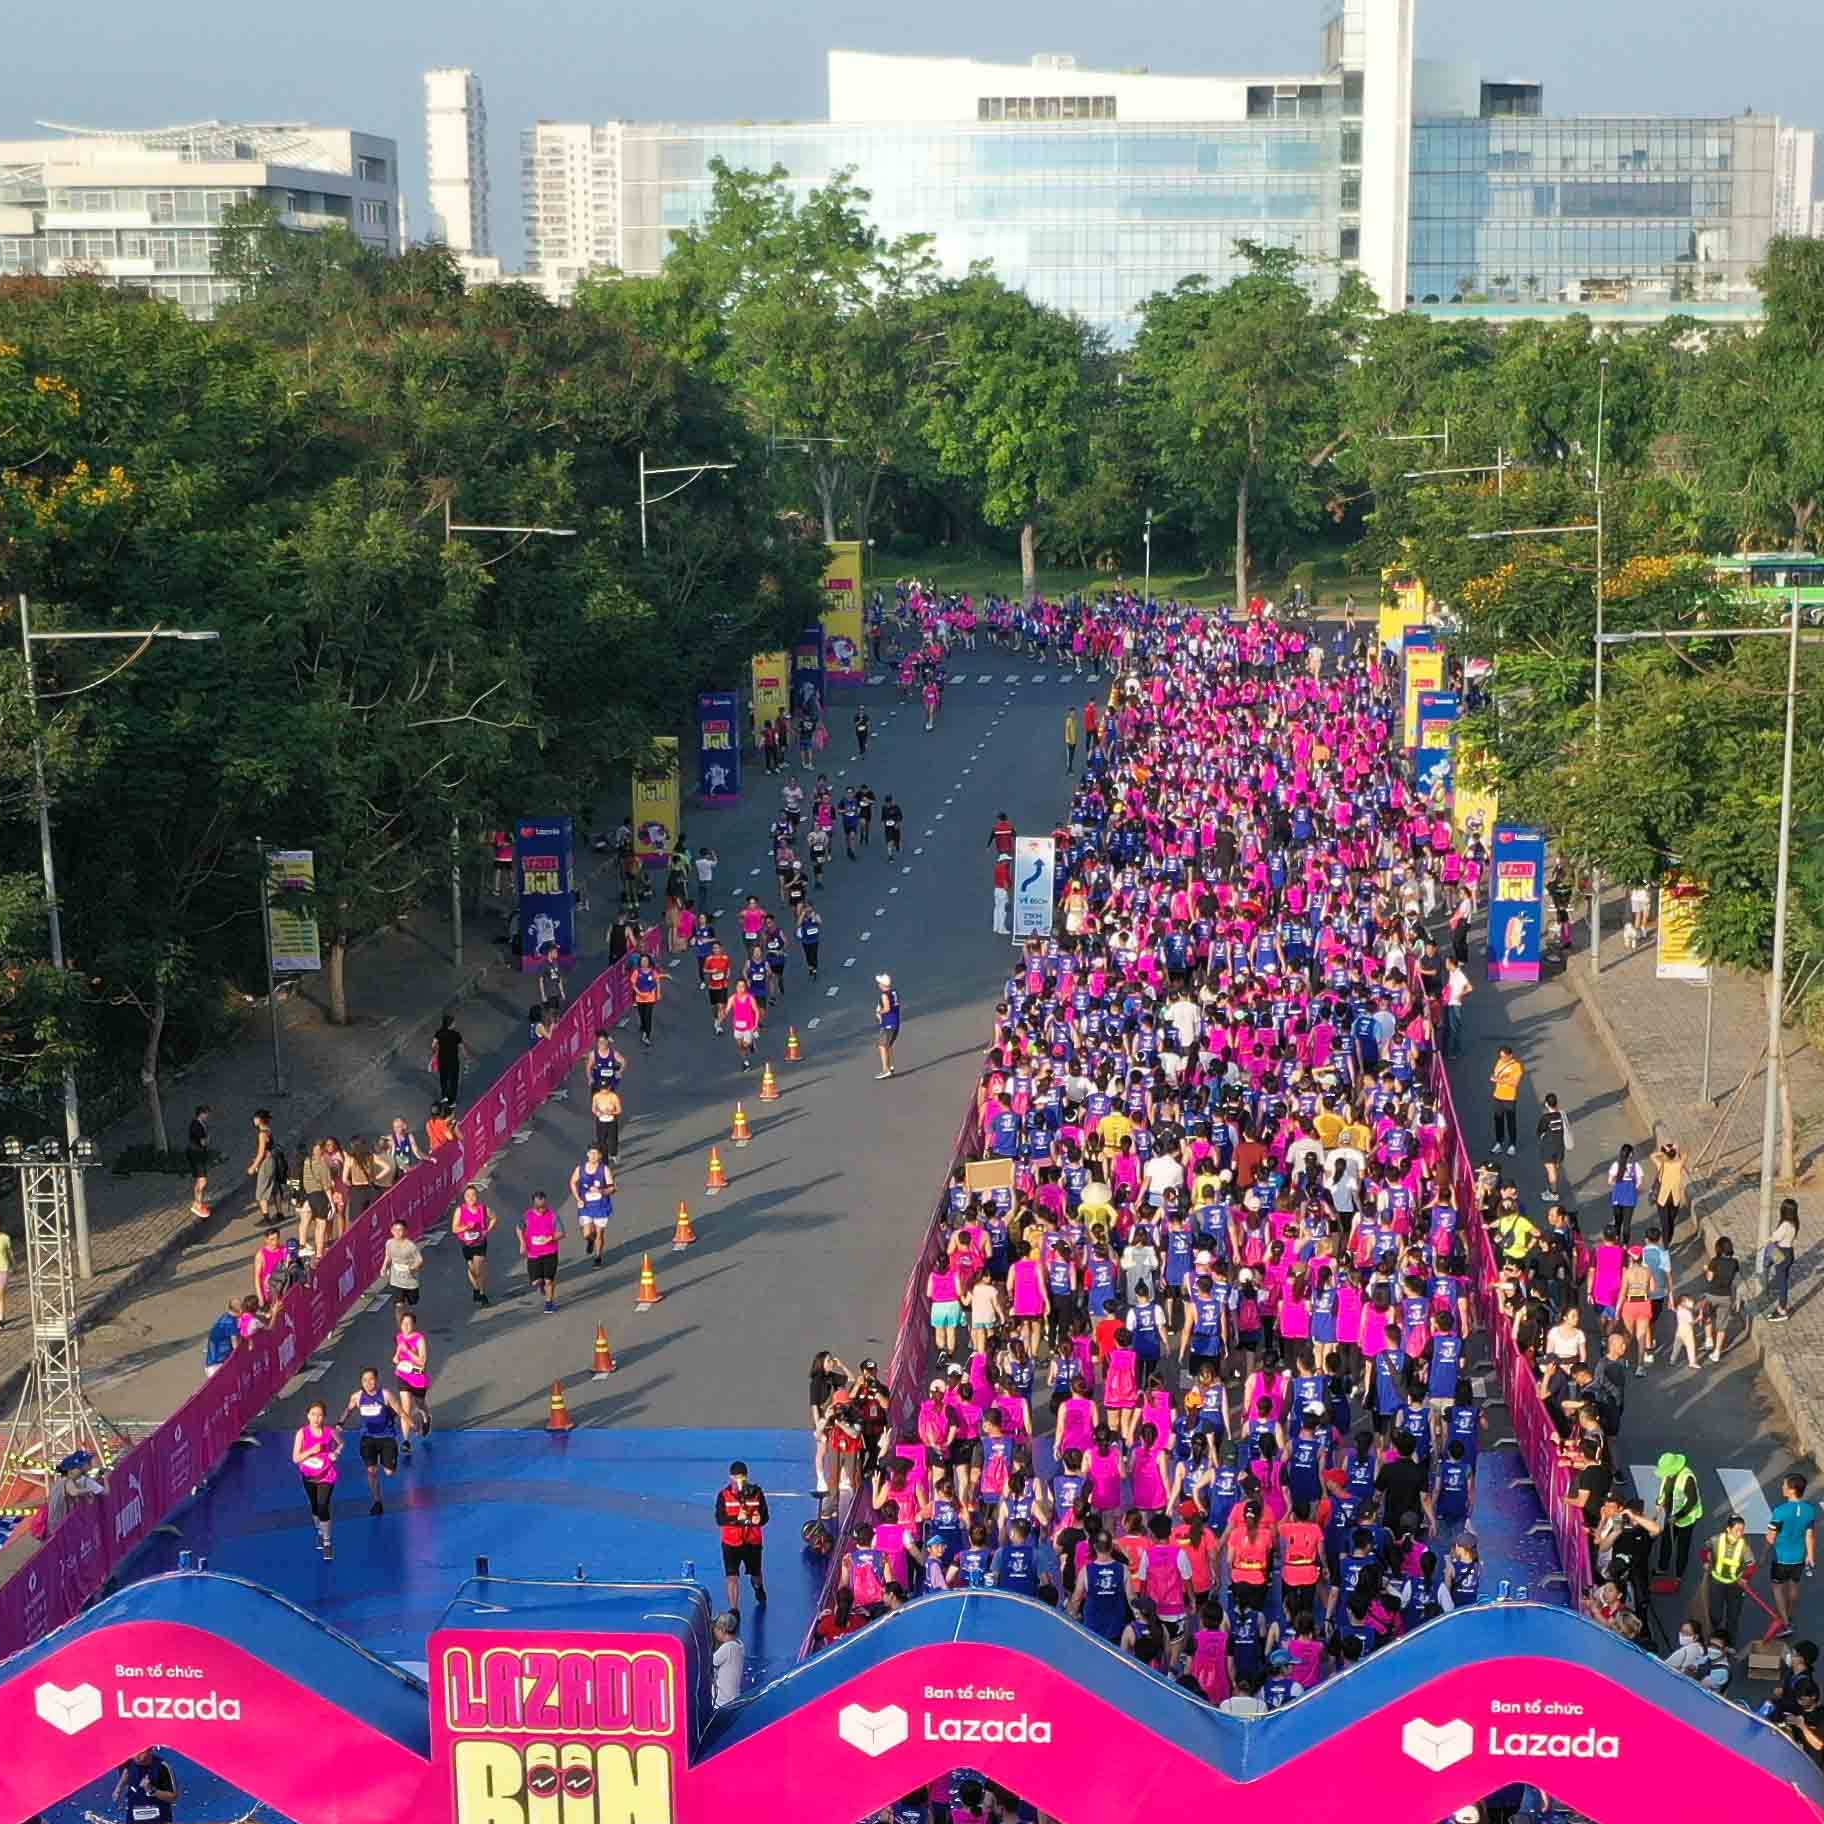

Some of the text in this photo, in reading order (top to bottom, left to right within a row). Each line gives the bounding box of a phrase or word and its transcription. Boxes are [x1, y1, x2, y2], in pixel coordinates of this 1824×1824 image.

[115, 1664, 144, 1677] Ban
[117, 1690, 241, 1721] Lazada
[443, 1647, 676, 1735] LAZADA
[924, 1686, 954, 1700] Ban
[1491, 1700, 1520, 1714] Ban
[924, 1712, 1052, 1744] Lazada
[1489, 1726, 1620, 1758] Lazada
